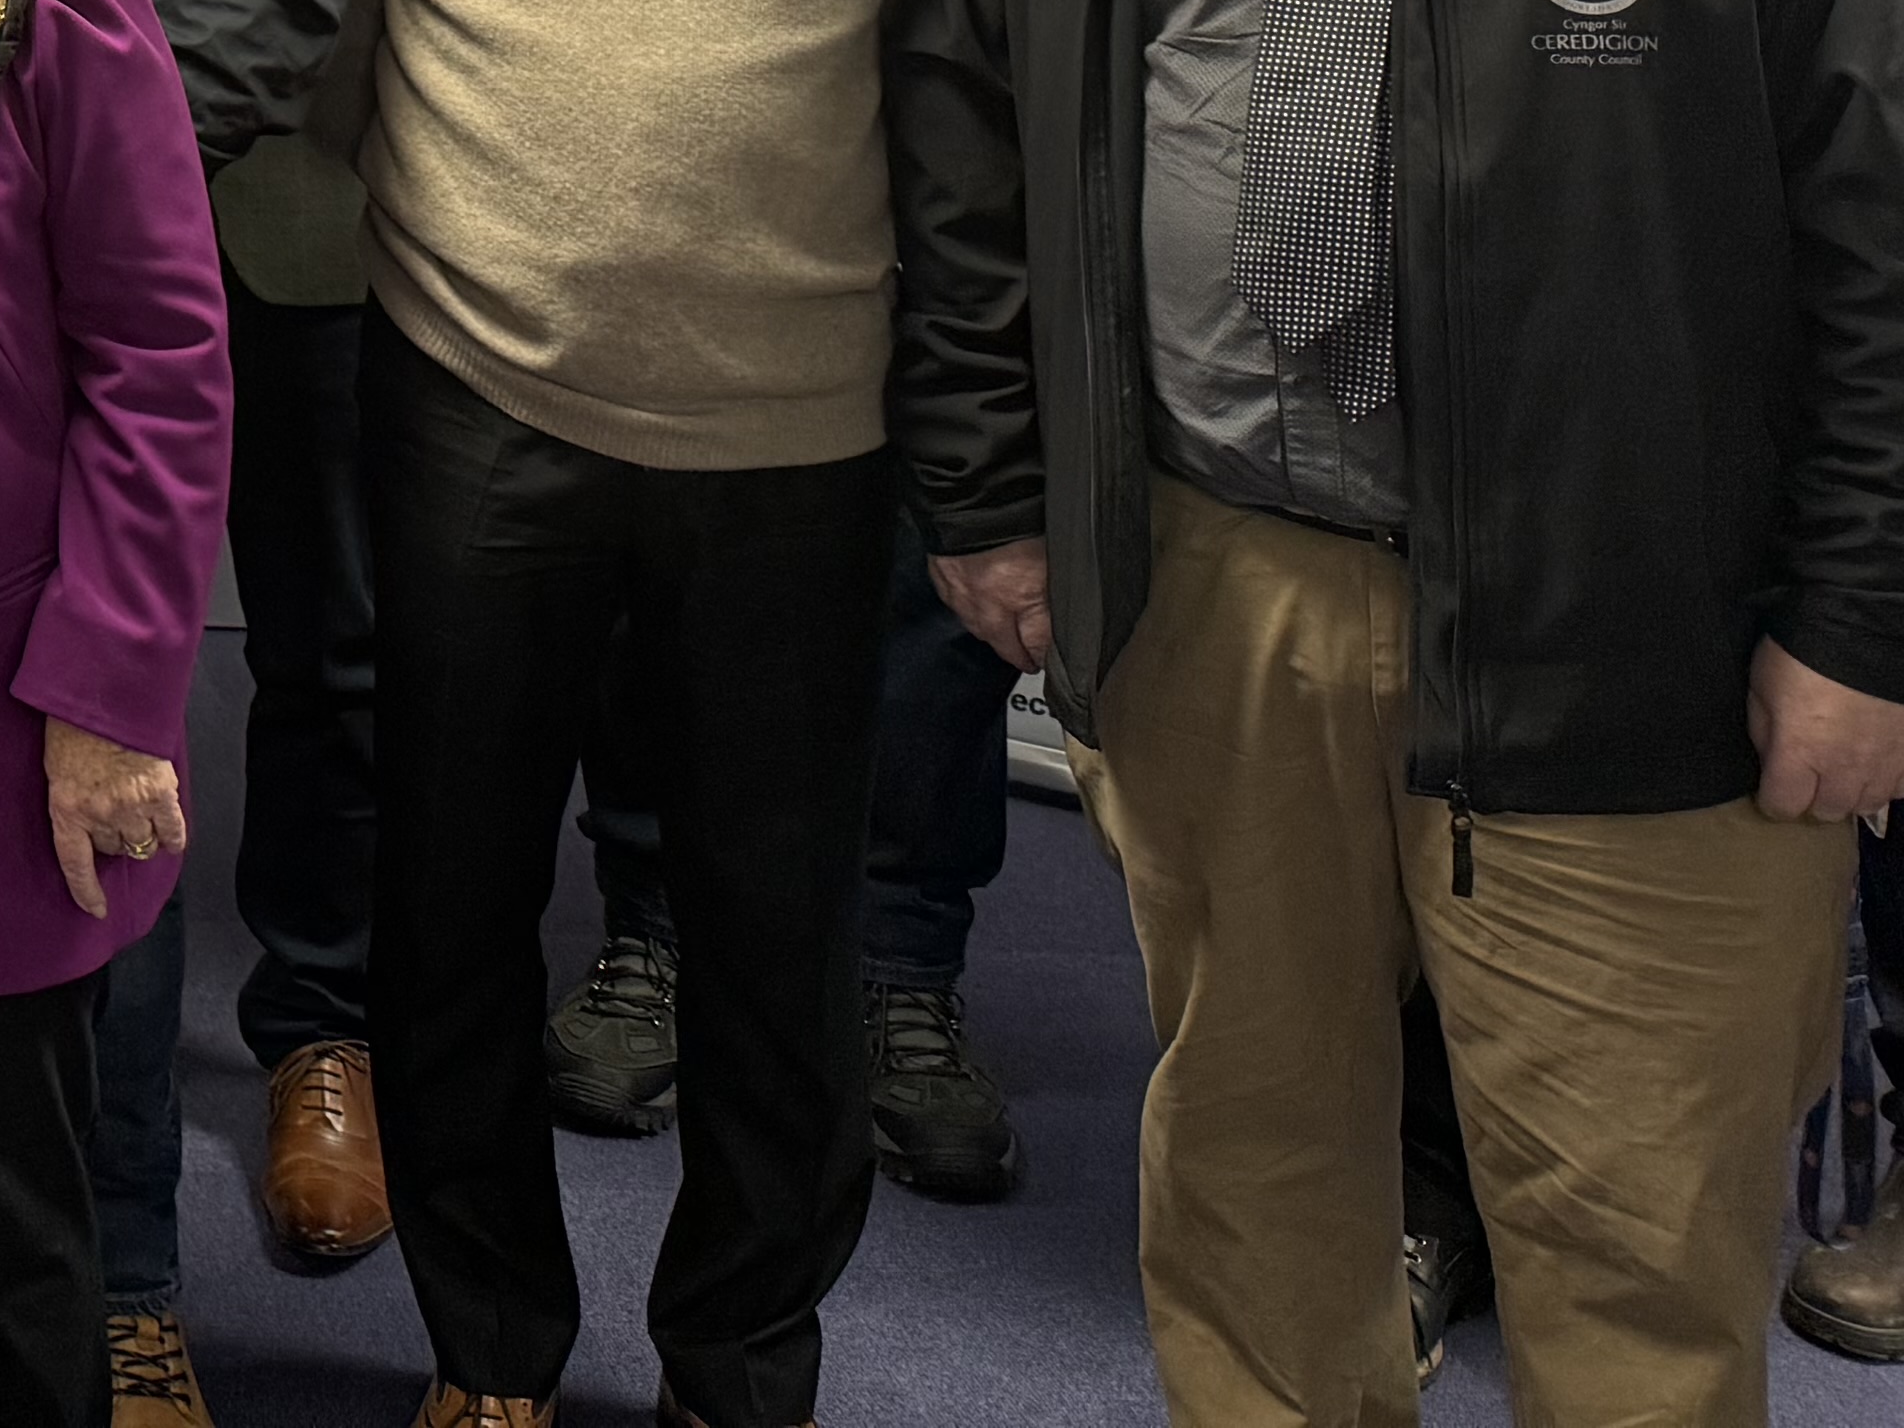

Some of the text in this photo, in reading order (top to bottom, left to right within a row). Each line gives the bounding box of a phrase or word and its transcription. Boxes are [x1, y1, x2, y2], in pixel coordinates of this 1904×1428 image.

[1562, 18, 1628, 32] Cyngor Sir
[1530, 34, 1659, 52] CEREDIGION
[1550, 53, 1642, 68] County Council
